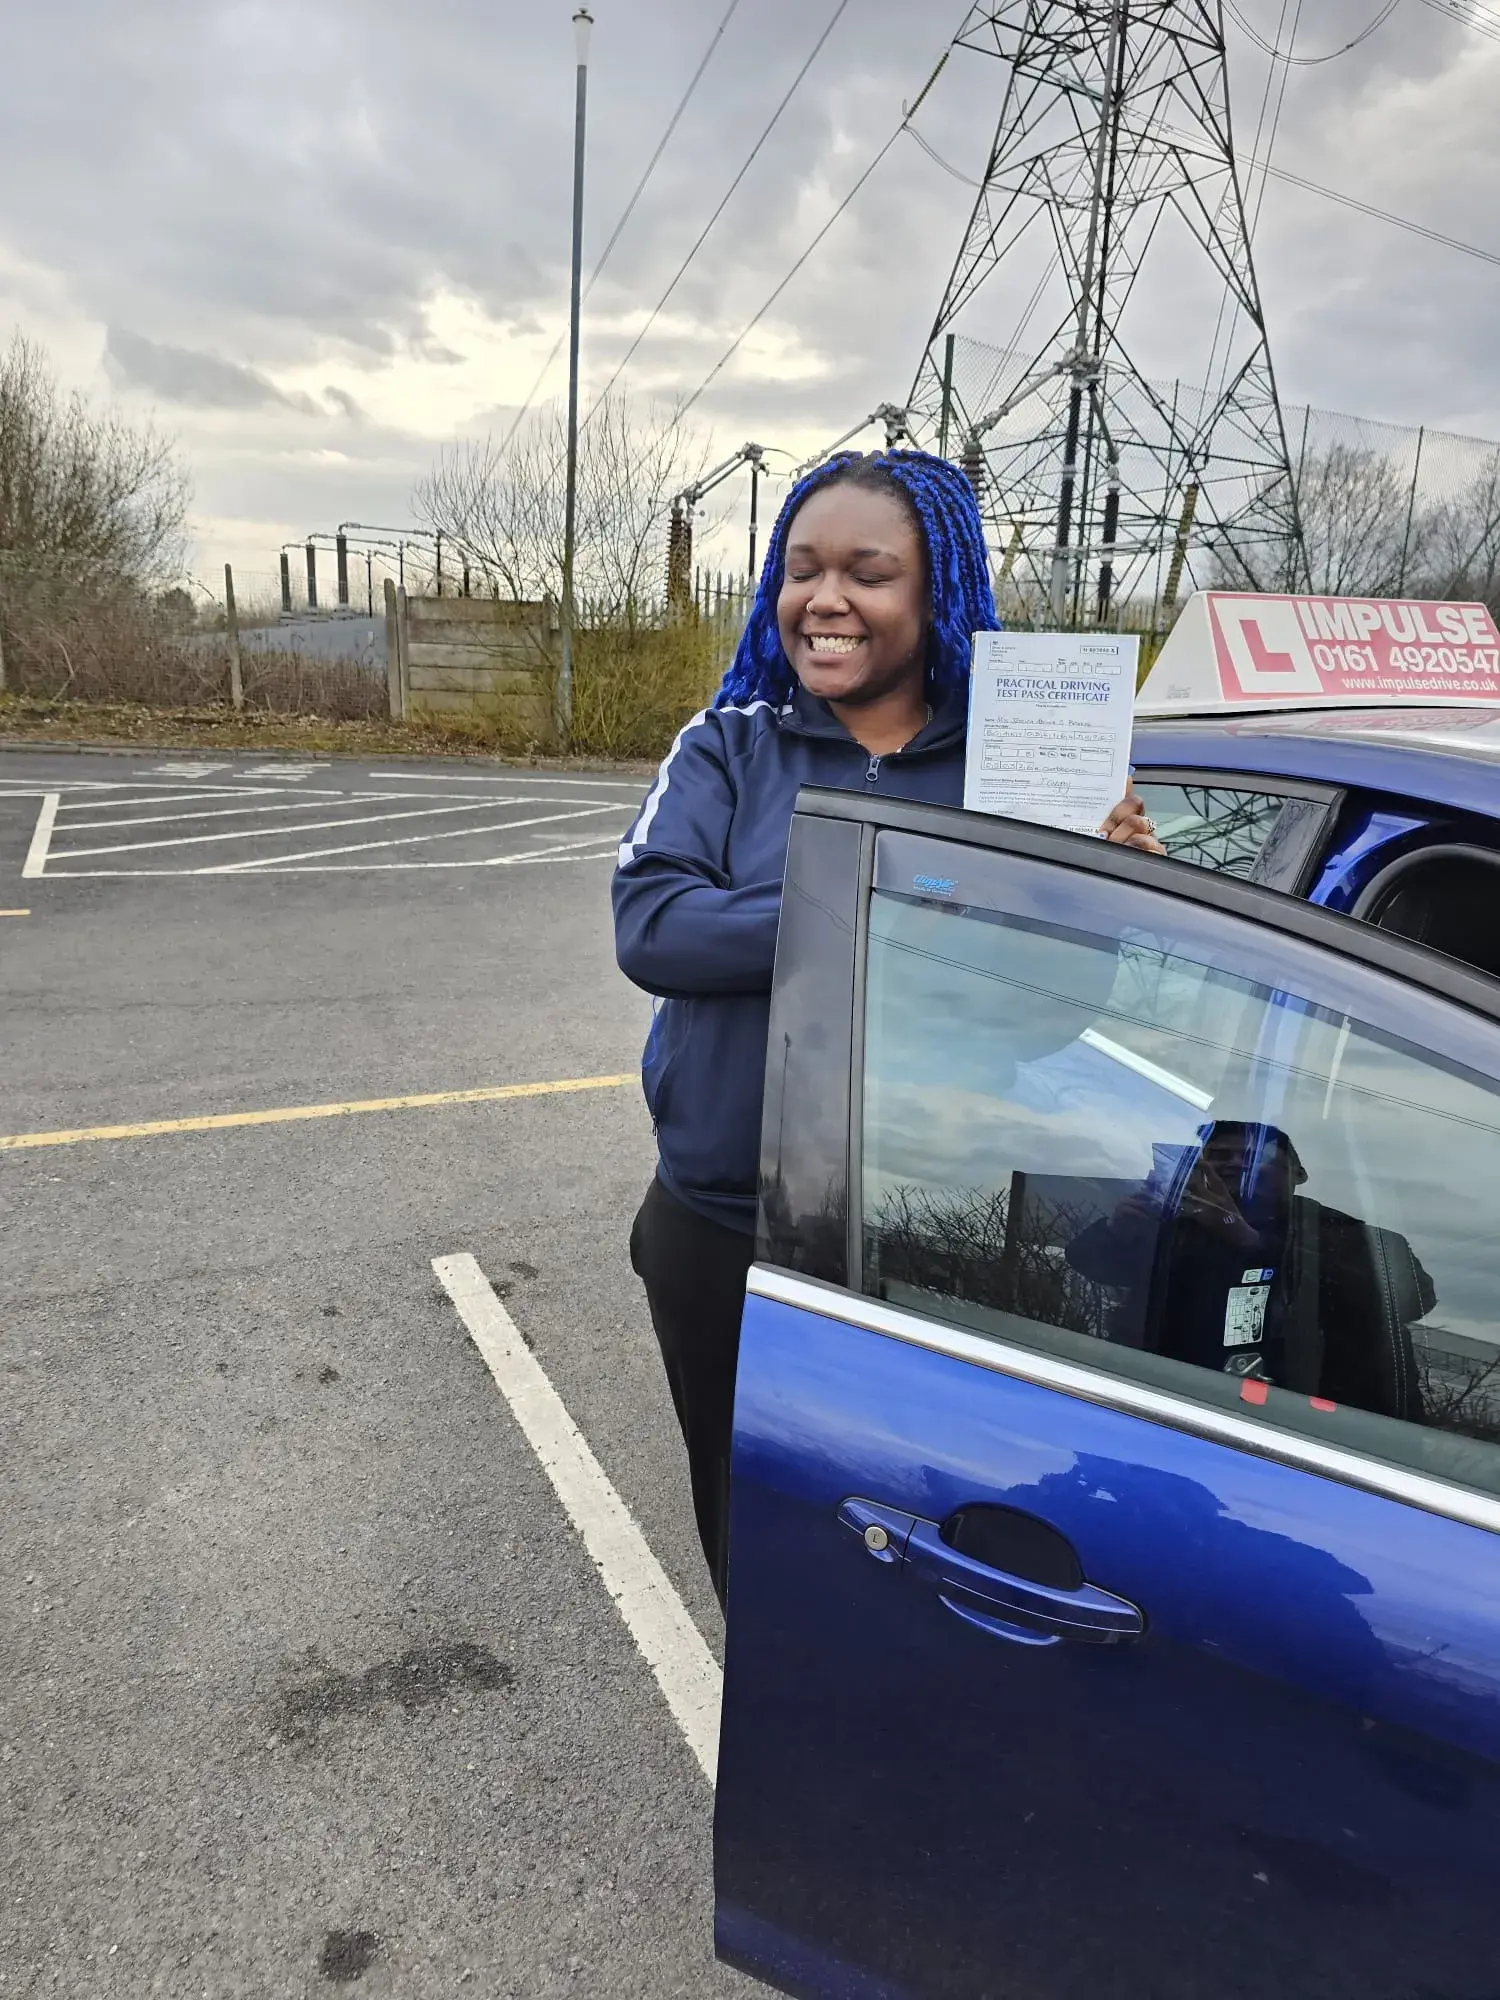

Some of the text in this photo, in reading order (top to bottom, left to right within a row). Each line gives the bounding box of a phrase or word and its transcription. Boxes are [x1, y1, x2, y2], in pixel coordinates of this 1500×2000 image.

[1297, 601, 1495, 644] IMPULSE
[1239, 619, 1296, 672] L
[1313, 644, 1500, 673] 0161 4920547
[996, 678, 1110, 692] PRACTICAL DRIVING
[1342, 677, 1498, 691] www.impulsedrive.co.uk
[996, 689, 1110, 702] TEST PASS CERTIFICATE
